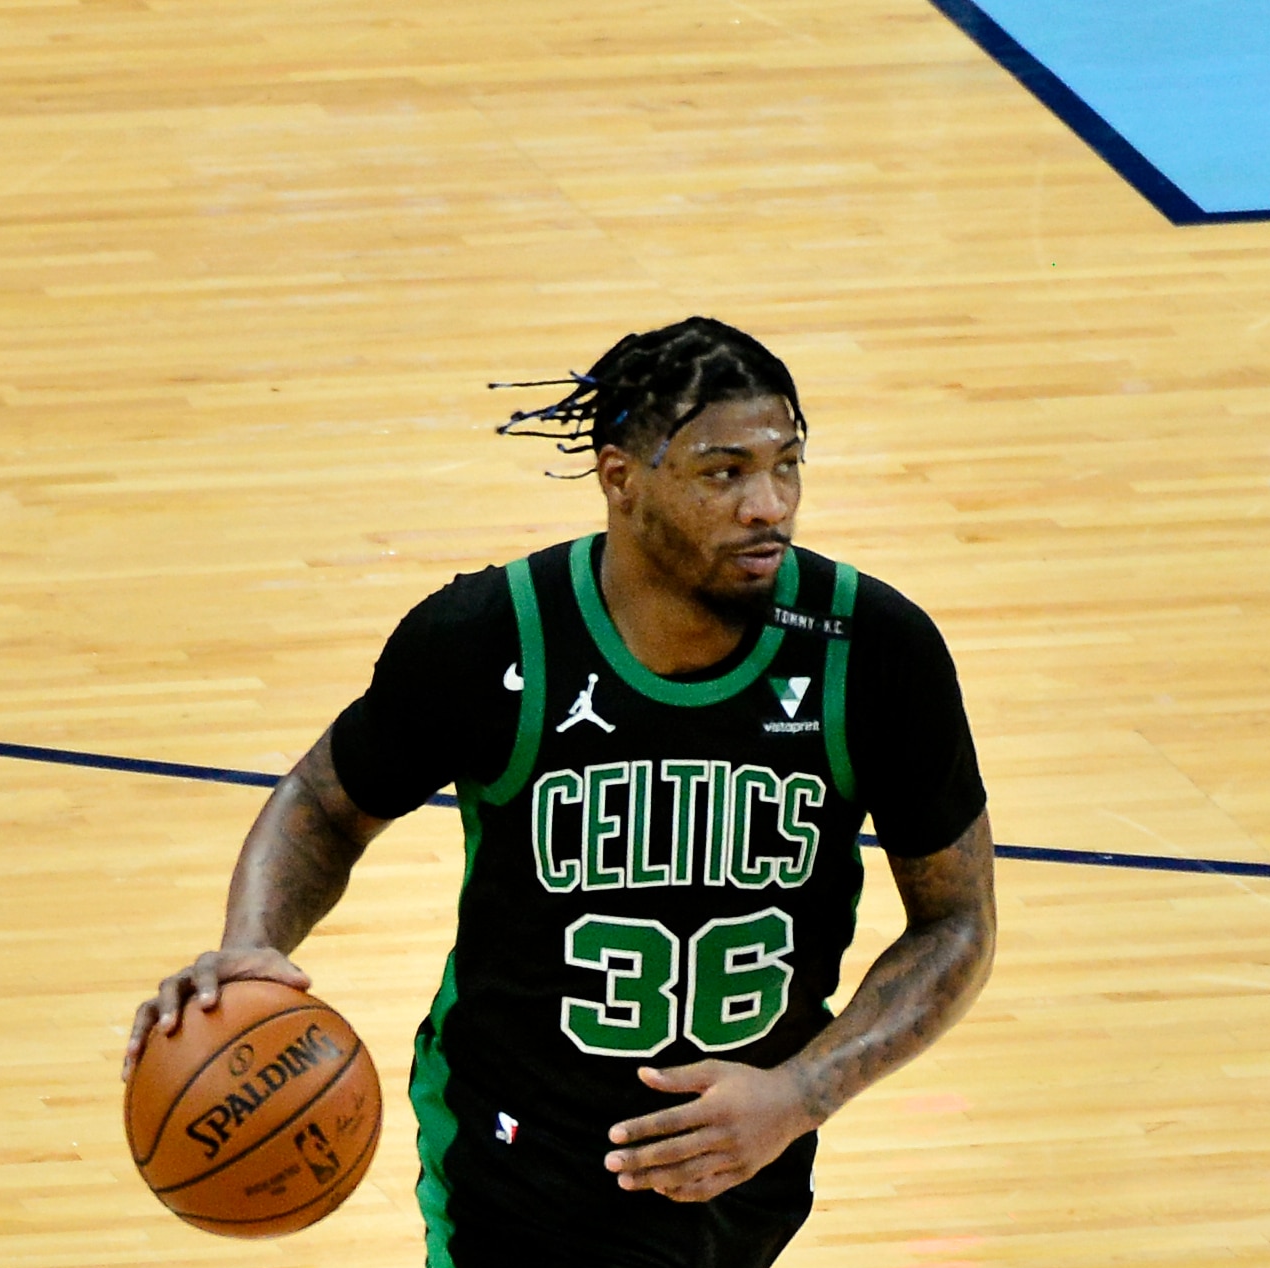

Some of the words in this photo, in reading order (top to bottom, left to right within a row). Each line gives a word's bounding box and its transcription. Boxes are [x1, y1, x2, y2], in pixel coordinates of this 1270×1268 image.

[774, 607, 815, 630] TOMMY
[763, 720, 820, 734] vistaprint
[532, 760, 826, 892] CELTICS
[560, 906, 794, 1057] 36
[186, 1023, 342, 1159] SPALDING
